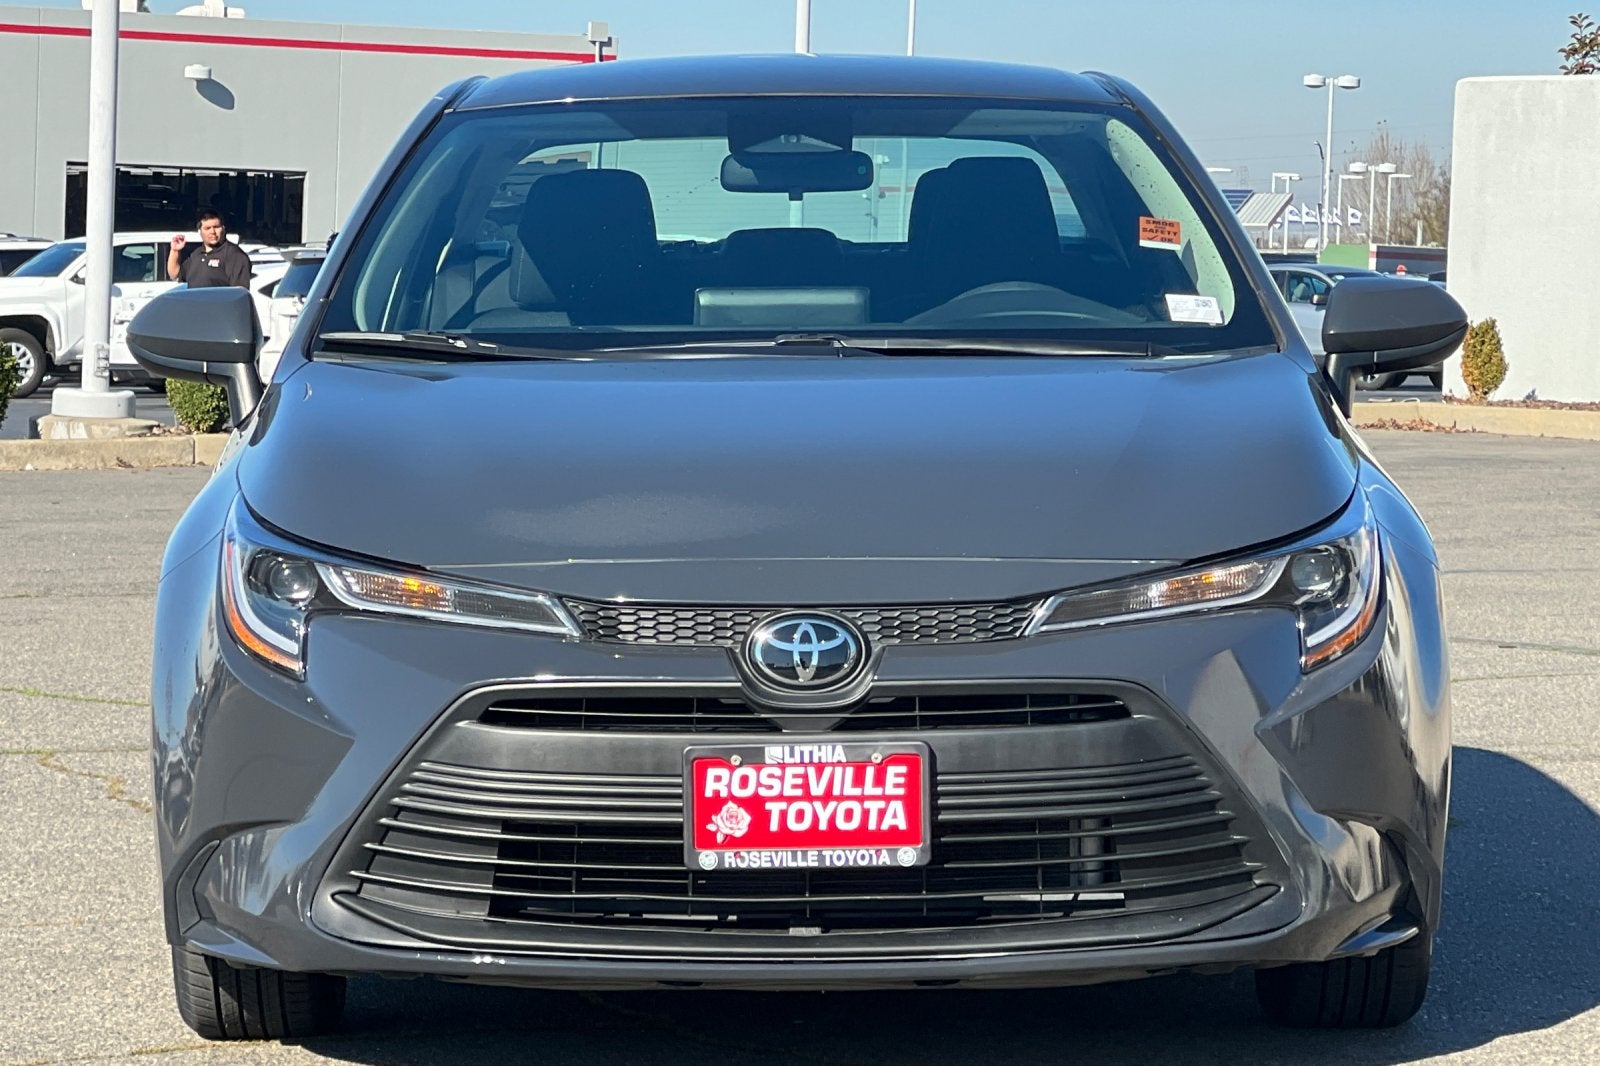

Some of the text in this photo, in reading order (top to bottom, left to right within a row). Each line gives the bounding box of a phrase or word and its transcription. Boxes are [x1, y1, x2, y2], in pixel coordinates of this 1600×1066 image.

[1142, 227, 1178, 236] SAFETY
[784, 744, 847, 764] LITHIA
[704, 766, 908, 799] ROSEVILLE
[765, 800, 908, 832] TOYOTA
[724, 849, 891, 868] ROSEVILLE TOYOTA
